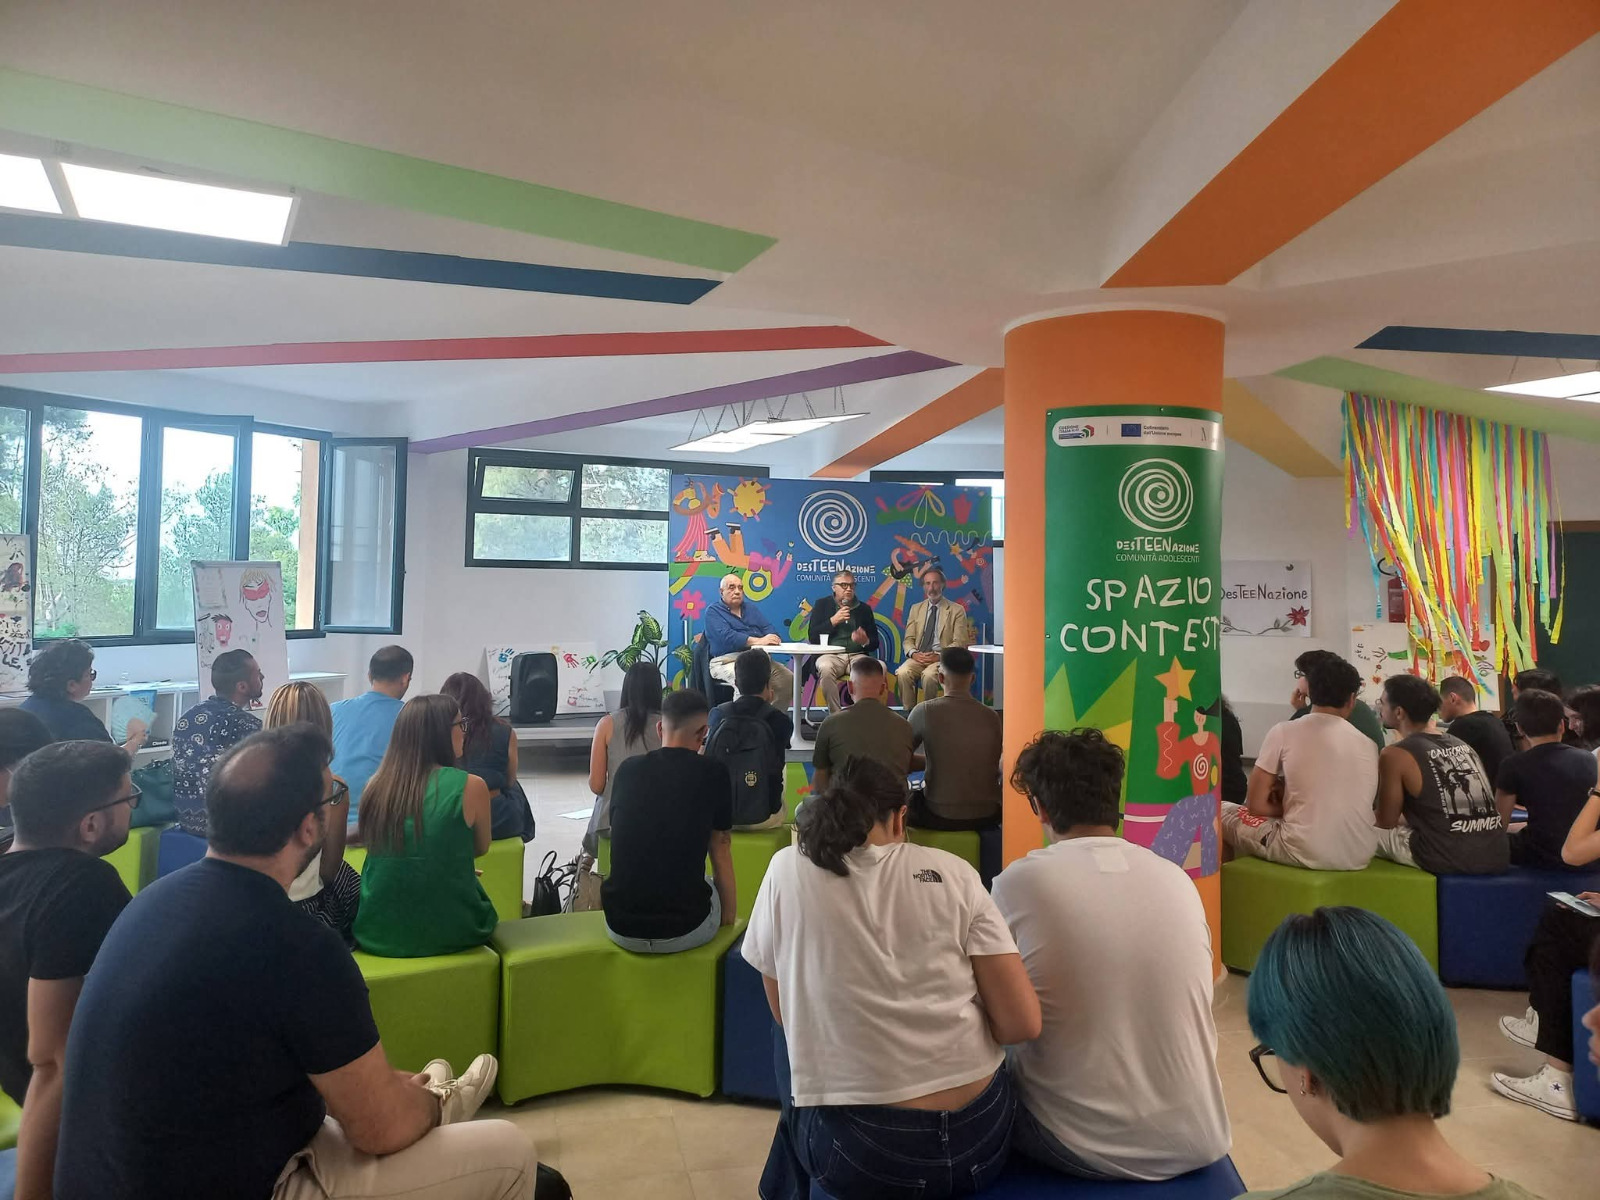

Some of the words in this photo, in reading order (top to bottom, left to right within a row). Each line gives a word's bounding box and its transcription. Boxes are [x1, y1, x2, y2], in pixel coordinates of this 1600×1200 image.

[1115, 553, 1157, 562] COMUNITÀ
[1158, 554, 1200, 563] ADOLESCENTI
[796, 573, 831, 582] COMUNITÀ
[1086, 574, 1212, 611] SPAZIO
[1060, 616, 1220, 656] CONTEST
[1449, 815, 1503, 833] SUMMER
